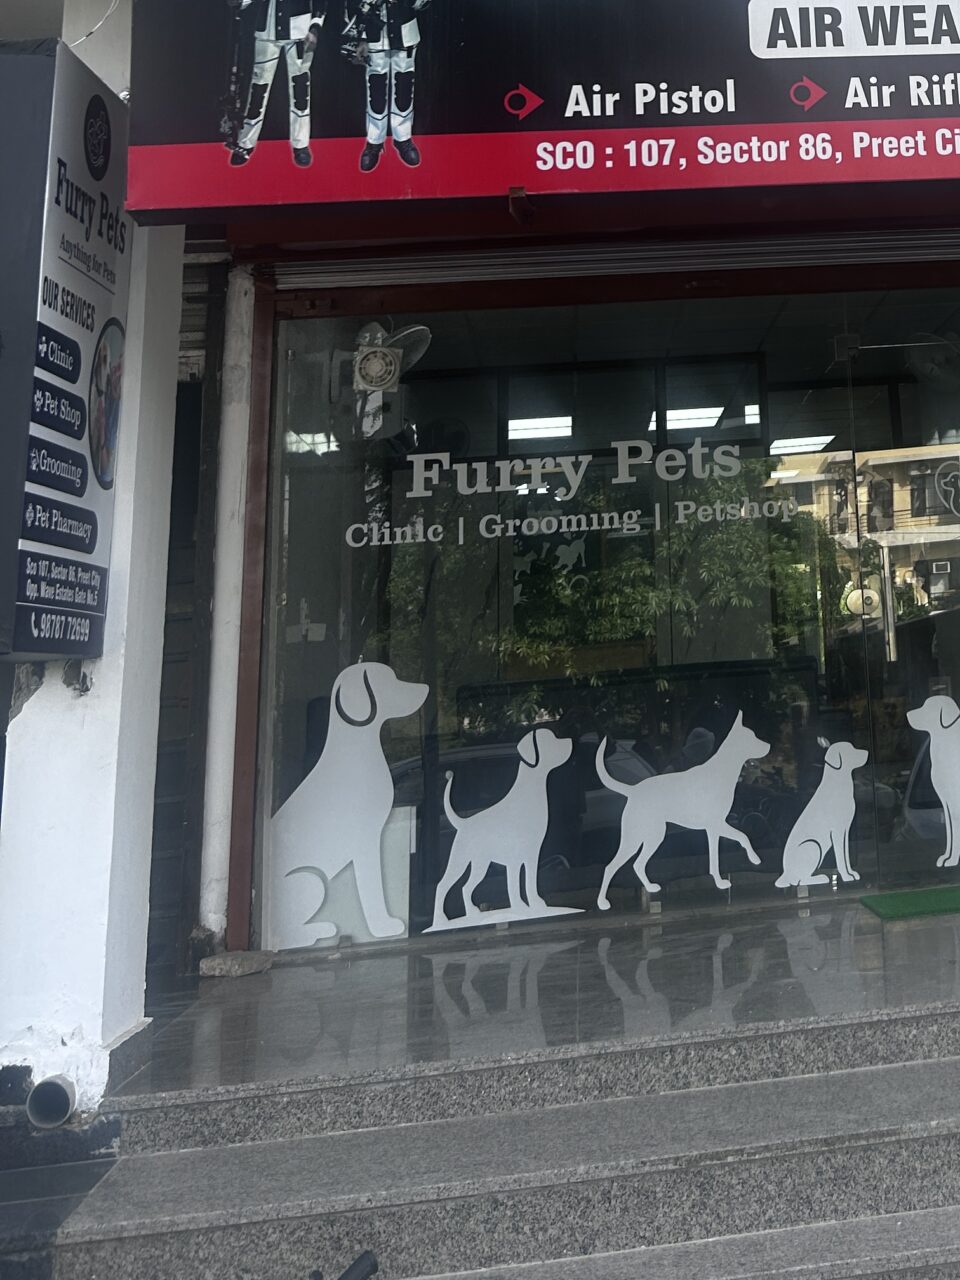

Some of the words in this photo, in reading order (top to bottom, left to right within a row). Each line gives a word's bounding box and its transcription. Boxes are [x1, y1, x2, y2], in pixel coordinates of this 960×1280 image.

[766, 6, 845, 49] AIR
[564, 83, 620, 118] Air
[634, 78, 737, 116] Pistol
[844, 76, 896, 109] Air
[536, 141, 595, 171] SCO
[623, 138, 687, 170] 107,
[696, 135, 790, 165] Sector
[798, 133, 842, 164] 86,
[852, 130, 927, 159] Preet
[54, 156, 97, 243] Furry
[97, 191, 126, 255] Pets
[59, 233, 93, 274] Anything
[92, 253, 102, 277] for
[102, 263, 117, 285] Pets
[42, 275, 60, 313] OUR
[60, 285, 96, 334] SERVICES
[48, 340, 74, 371] Clinic
[43, 391, 59, 416] Pet
[59, 396, 81, 430] Shop
[39, 449, 82, 487] Grooming
[405, 451, 593, 502] Furry
[611, 436, 742, 485] Pets
[34, 504, 49, 528] Pet
[51, 507, 92, 545] Pharmacy
[344, 518, 444, 548] Clinic
[478, 506, 642, 540] Grooming
[674, 496, 800, 524] Petshop
[40, 613, 65, 640] 98787
[67, 615, 90, 642] 72699
